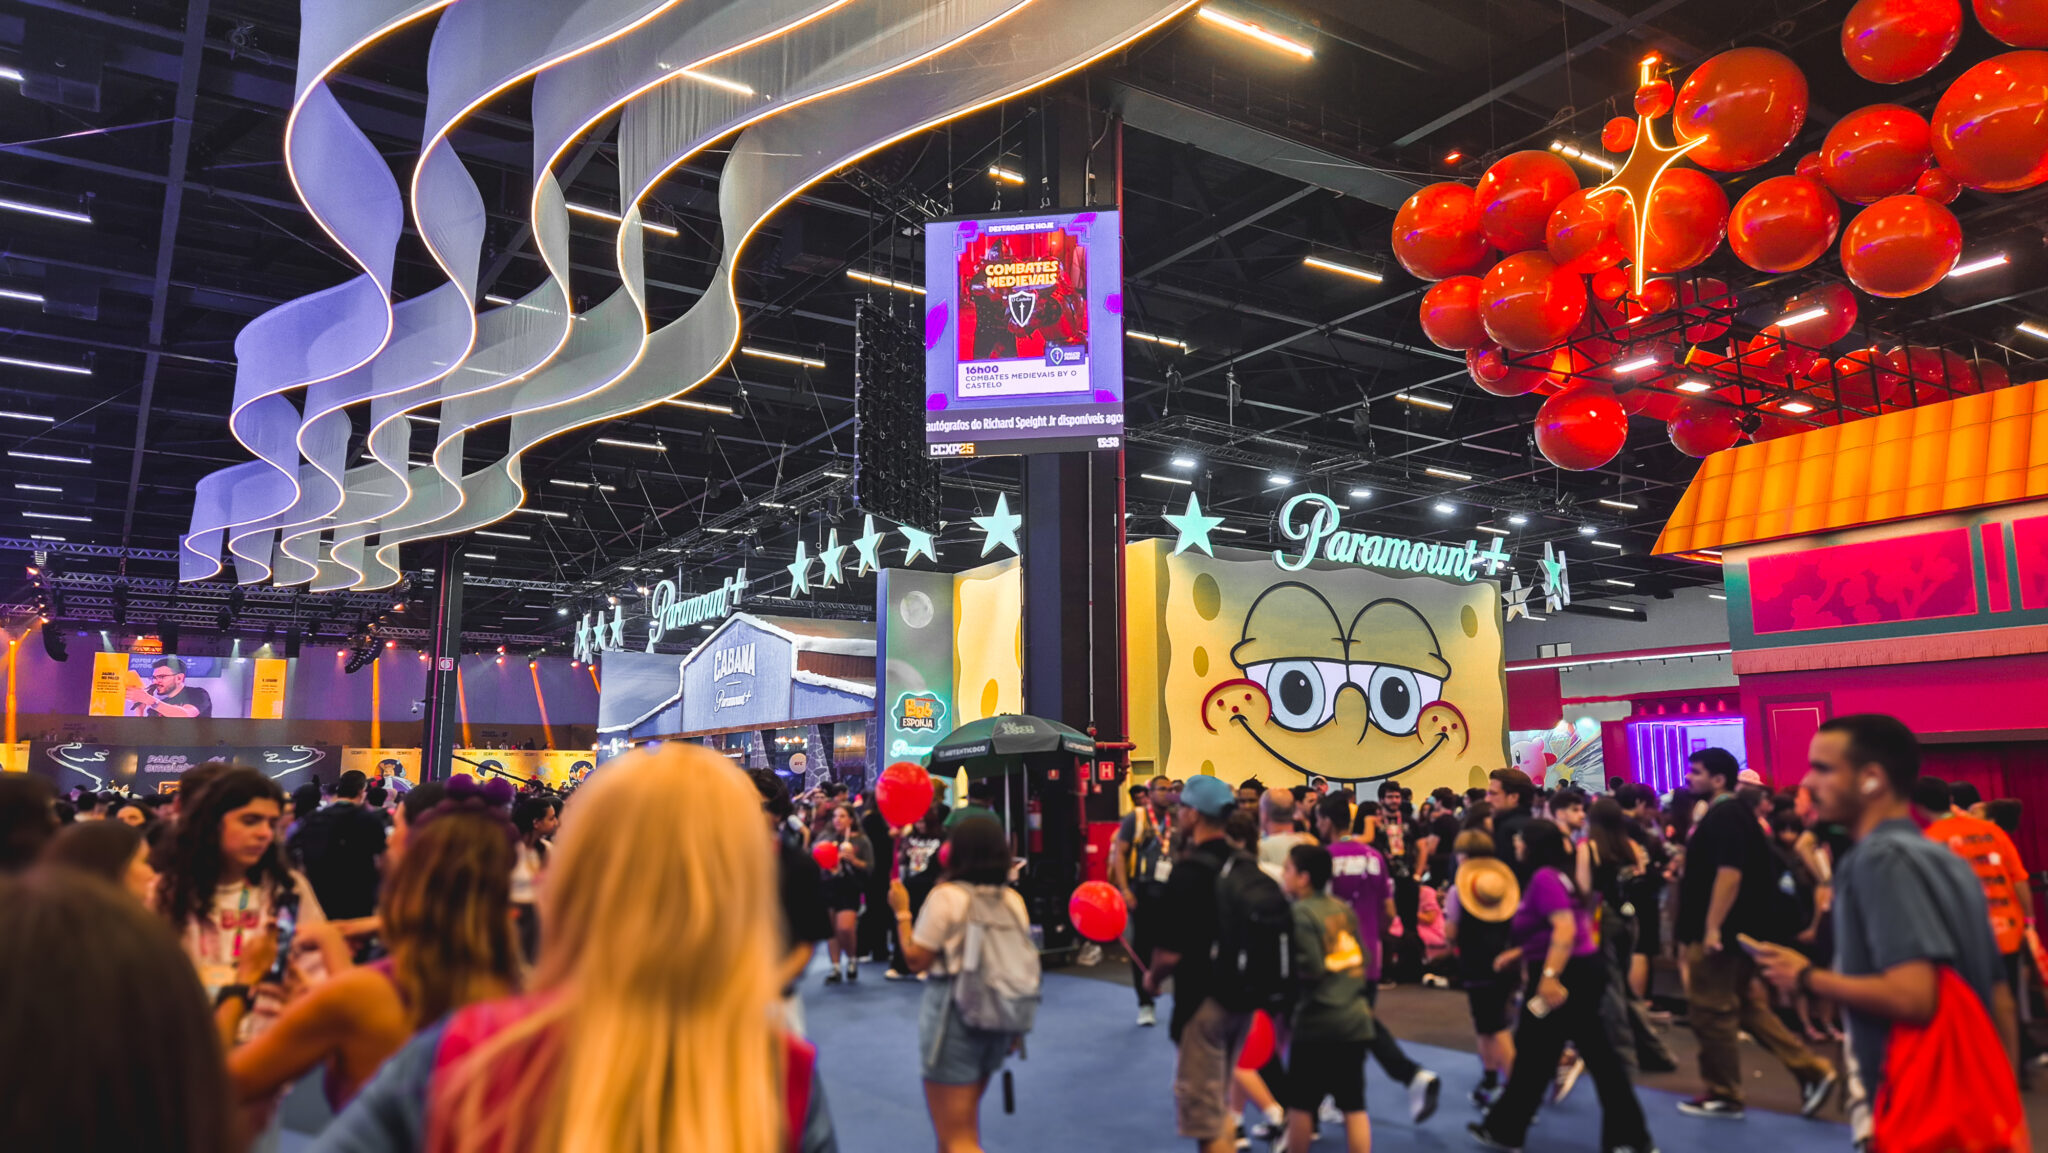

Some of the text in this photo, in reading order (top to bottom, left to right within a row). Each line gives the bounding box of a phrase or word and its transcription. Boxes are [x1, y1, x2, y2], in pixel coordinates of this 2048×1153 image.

[985, 260, 1059, 276] COMBATES
[986, 273, 1058, 289] MEDIEVAIS
[965, 365, 999, 374] 16h00
[965, 373, 1009, 382] COMBATES
[1011, 371, 1055, 380] MEDIEVAIS
[1057, 370, 1068, 378] BY
[965, 381, 1002, 389] CASTELO
[926, 418, 970, 433] autógrafos
[970, 418, 982, 430] do
[983, 417, 1014, 430] Richard
[1015, 415, 1048, 429] Speight
[1048, 415, 1057, 427] Jr
[1057, 412, 1105, 427] disponíveis
[930, 442, 974, 456] CCXP25
[1272, 493, 1511, 581] Paramount+
[651, 567, 749, 643] Paramount+
[714, 642, 756, 682] CABANA
[905, 698, 933, 718] Bob
[902, 717, 933, 728] ESPONJA
